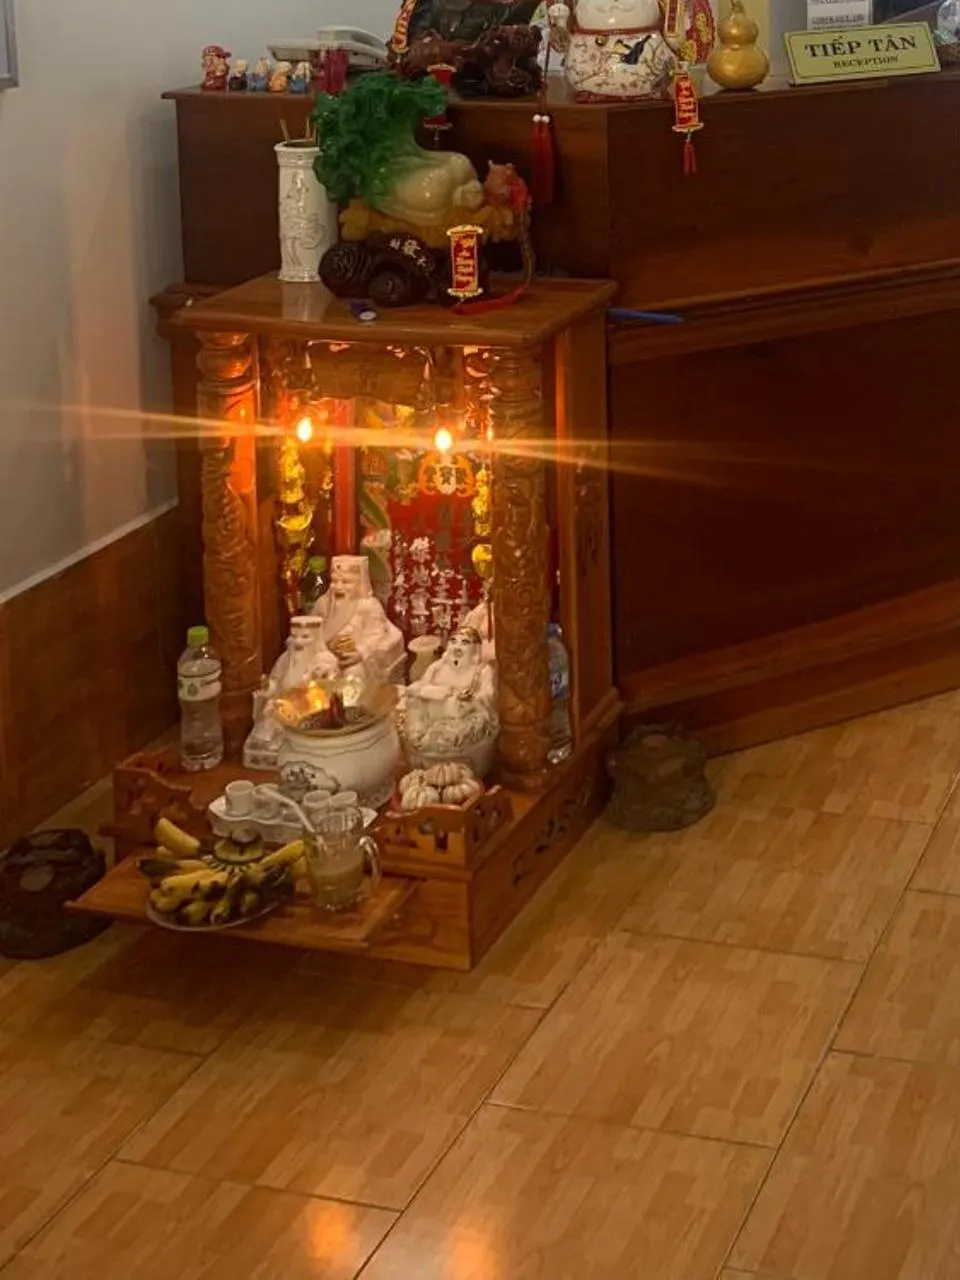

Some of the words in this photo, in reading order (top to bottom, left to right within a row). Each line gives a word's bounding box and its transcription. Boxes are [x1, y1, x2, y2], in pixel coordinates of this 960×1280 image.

[804, 35, 861, 58] TIẾP
[868, 34, 917, 51] TÂN
[833, 55, 899, 68] RECEPTION
